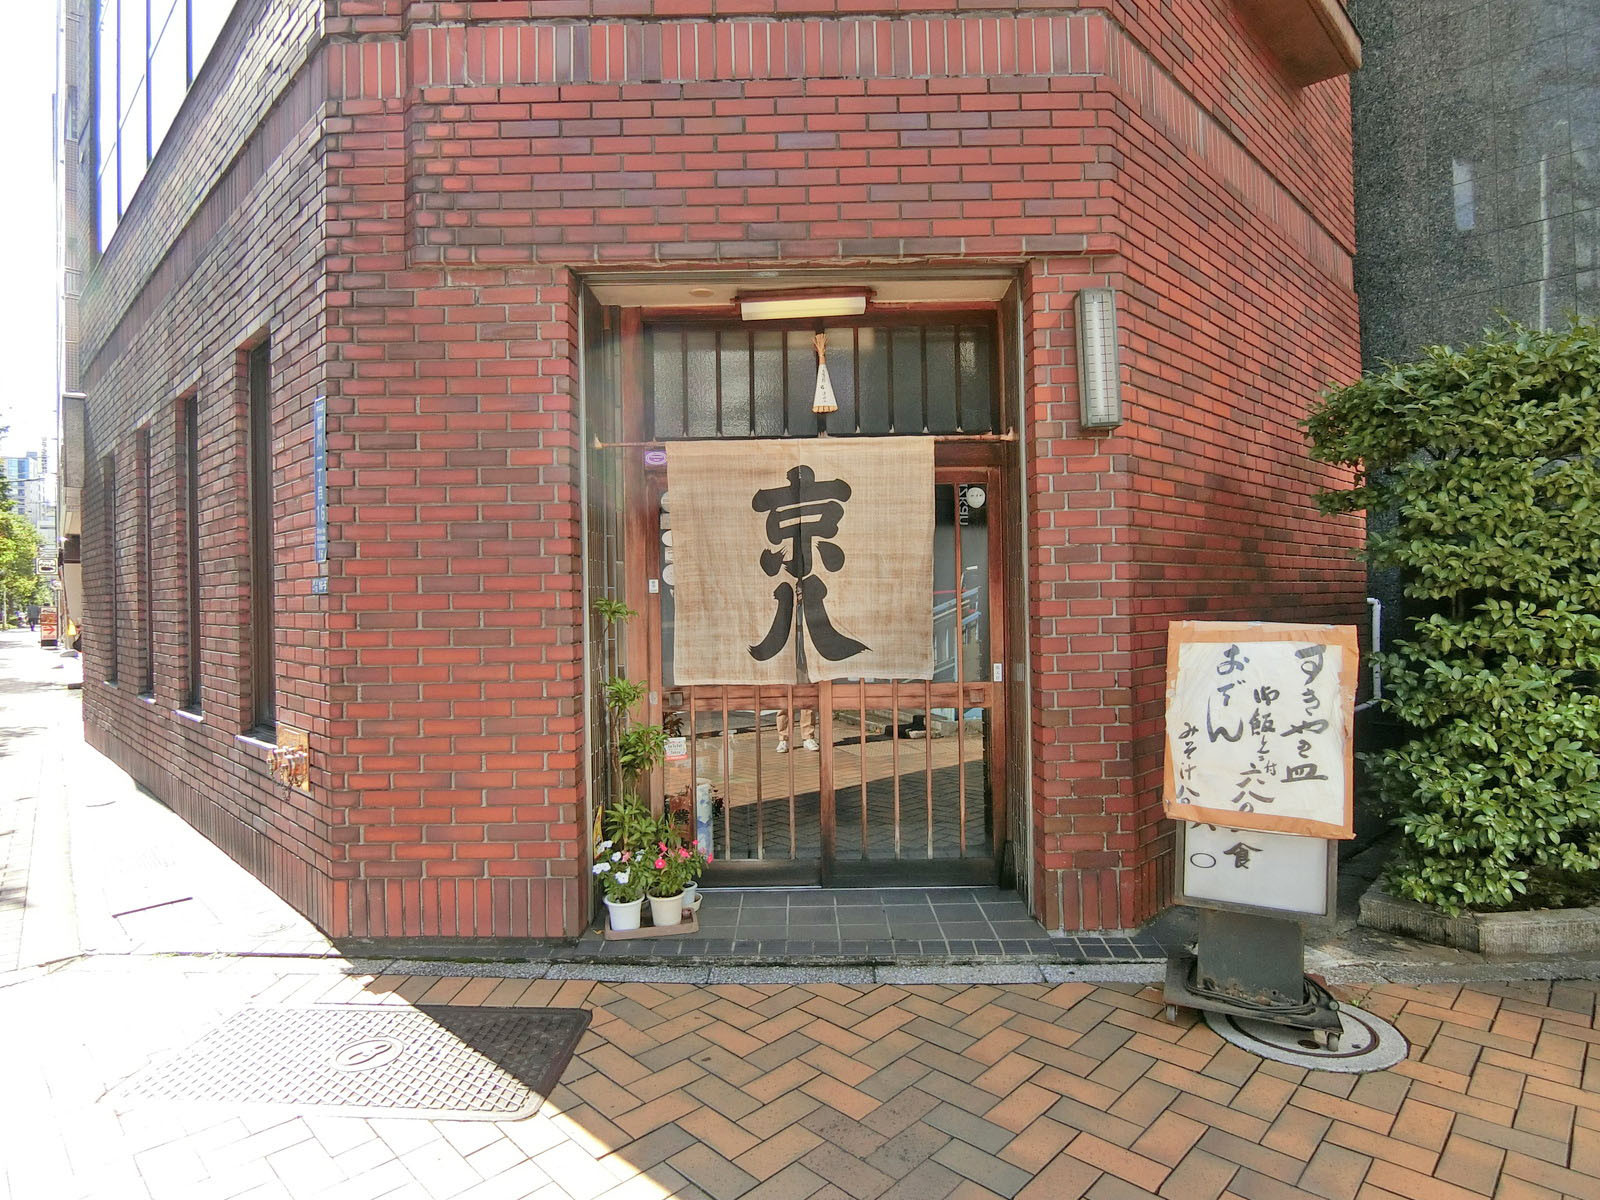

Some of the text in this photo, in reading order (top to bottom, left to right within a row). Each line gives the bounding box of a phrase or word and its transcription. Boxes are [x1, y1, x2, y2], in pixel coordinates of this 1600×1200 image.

[747, 465, 873, 661] 京八
[1207, 644, 1250, 743] おでん
[1223, 829, 1264, 870] 食
